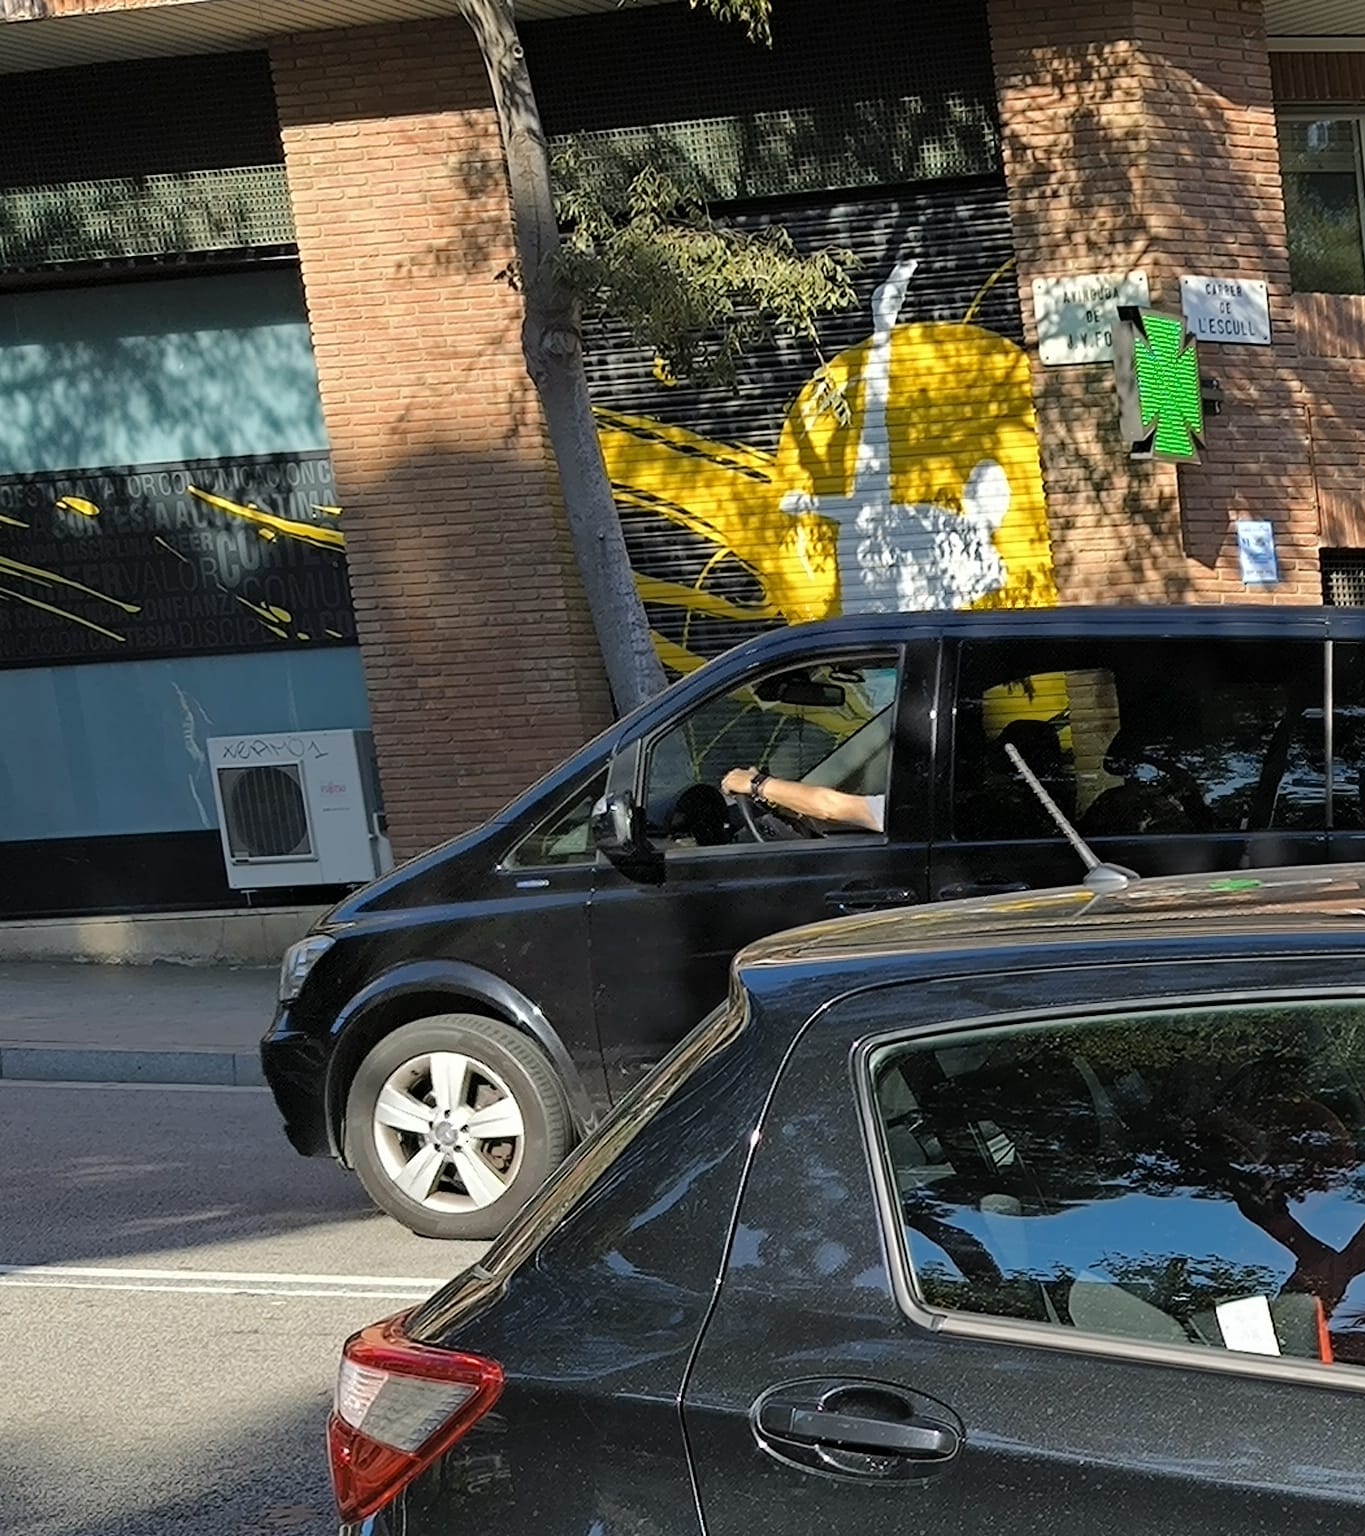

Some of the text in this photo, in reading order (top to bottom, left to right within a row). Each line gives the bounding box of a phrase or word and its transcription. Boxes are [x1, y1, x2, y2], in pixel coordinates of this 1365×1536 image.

[1063, 287, 1119, 304] AVINGUDA
[1205, 283, 1242, 297] CARRER
[1220, 302, 1231, 314] DE
[1086, 310, 1100, 323] DE
[1198, 318, 1256, 336] L'ESCULL
